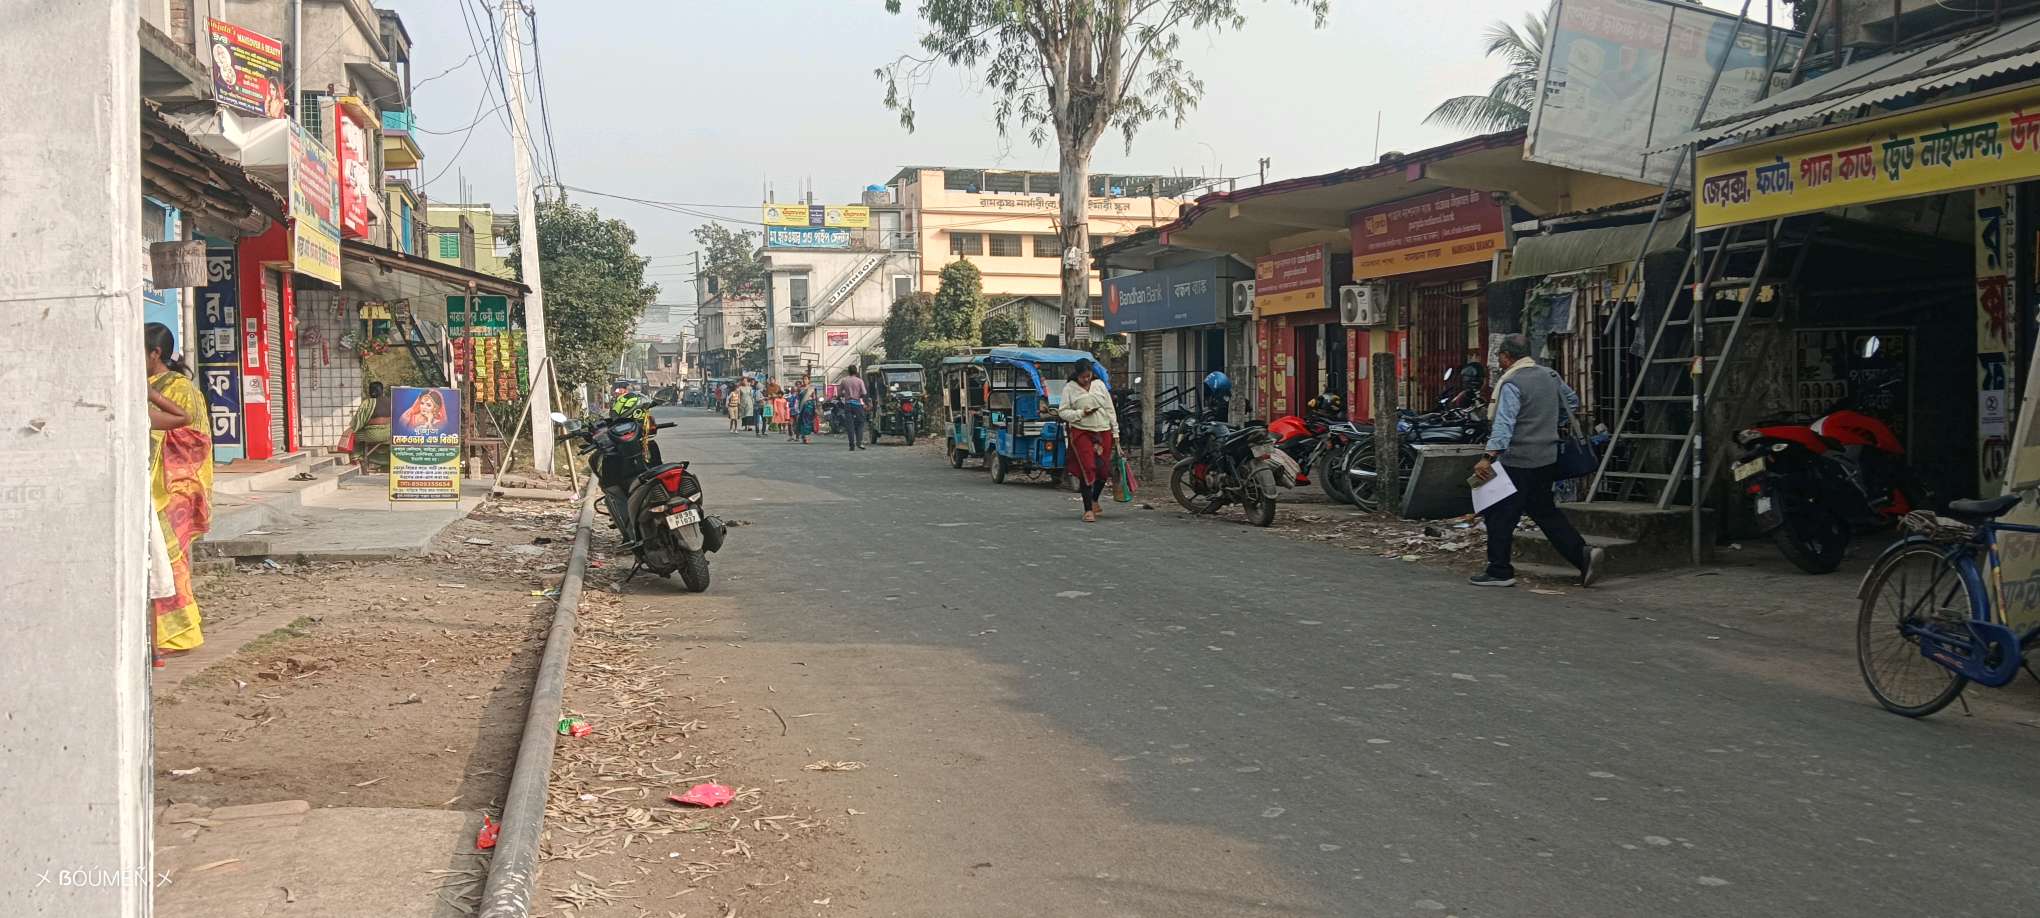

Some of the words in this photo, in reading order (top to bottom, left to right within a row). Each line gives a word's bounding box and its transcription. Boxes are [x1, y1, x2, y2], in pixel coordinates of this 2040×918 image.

[836, 257, 876, 298] JOHNSON
[1119, 286, 1146, 306] Bandhan
[1146, 284, 1162, 303] Bank
